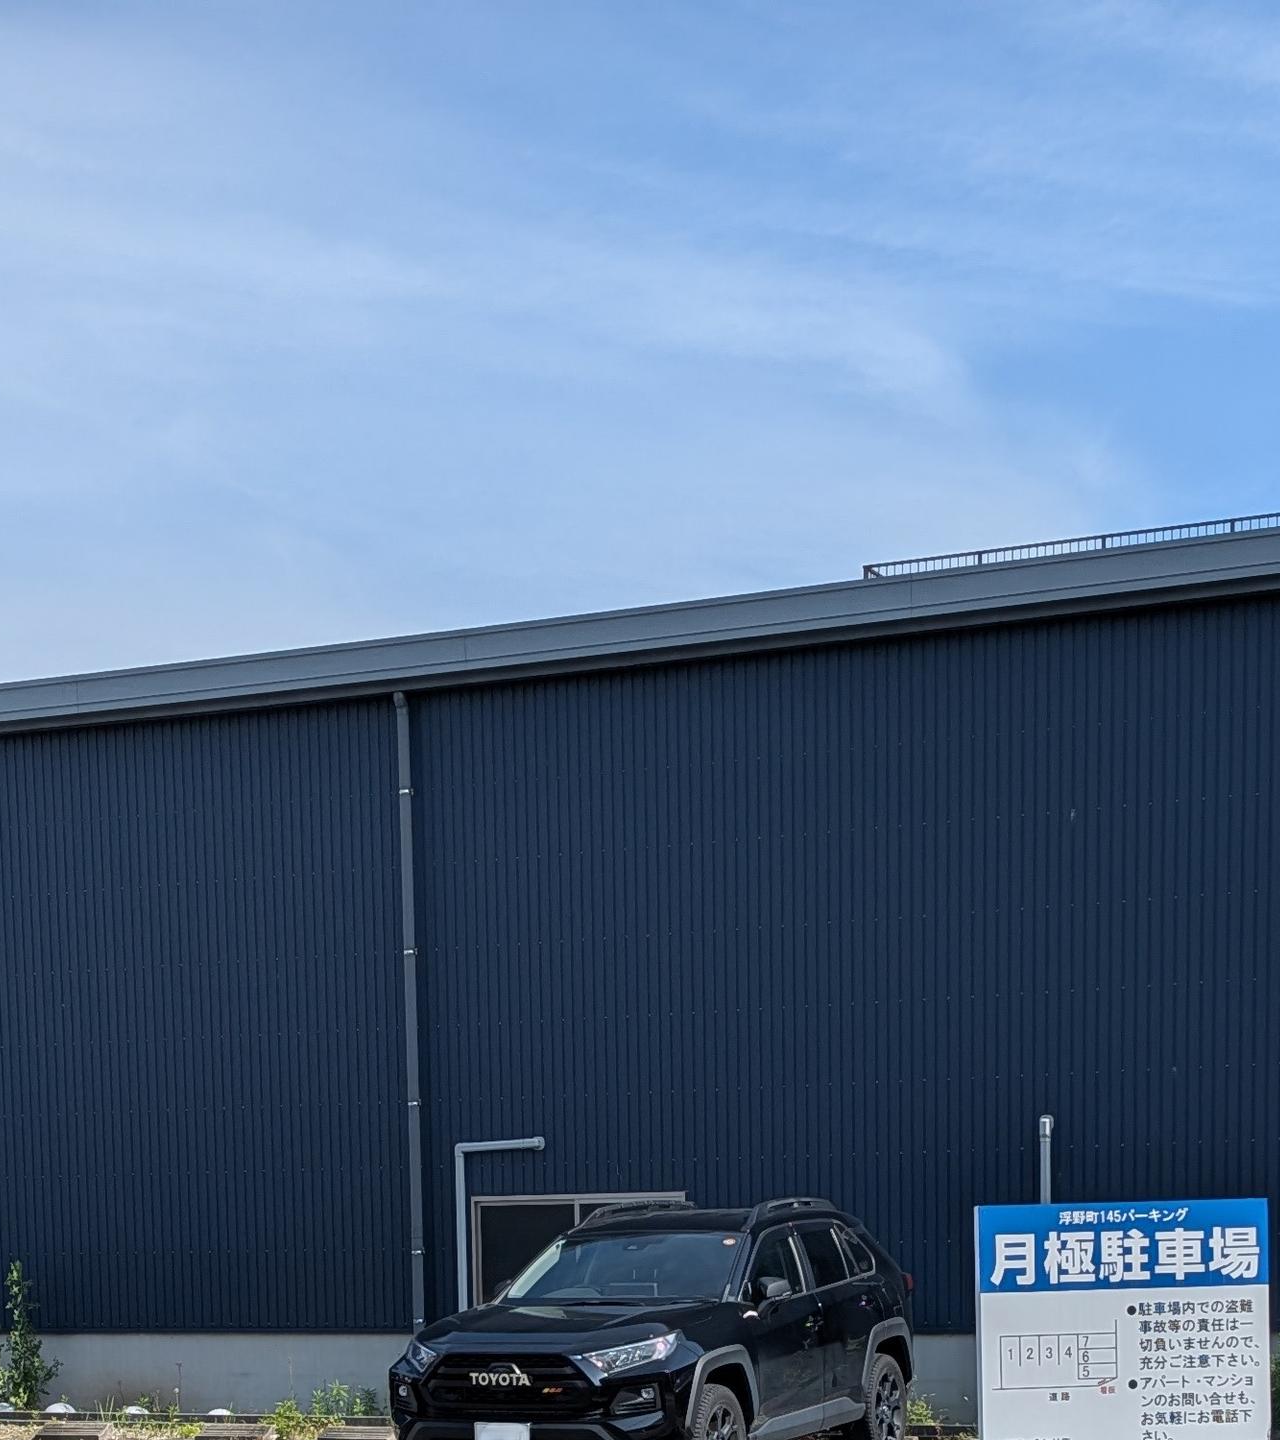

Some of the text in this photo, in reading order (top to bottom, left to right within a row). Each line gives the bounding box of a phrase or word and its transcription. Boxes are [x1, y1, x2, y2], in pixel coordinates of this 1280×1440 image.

[1059, 1207, 1189, 1225] 浮野町145パーキング
[990, 1227, 1261, 1287] 月極駐車場
[1138, 1299, 1254, 1317] 駐車場内での盗難
[1139, 1318, 1254, 1334] 事故等の責任は一
[1082, 1336, 1089, 1348] 7
[1139, 1336, 1260, 1352] 切負いませんので、
[1026, 1348, 1034, 1360] 2
[1045, 1347, 1053, 1359] 3
[1064, 1346, 1073, 1358] 4
[1082, 1350, 1090, 1363] 6
[1139, 1353, 1261, 1370] 充分ご注意下さい。
[469, 1373, 531, 1386] TOYOTA
[1082, 1365, 1090, 1378] 5
[1140, 1374, 1254, 1390] アパート・マンショ
[1141, 1391, 1256, 1408] ンのお問い合せも、
[1141, 1409, 1253, 1426] お気軽にお電話下
